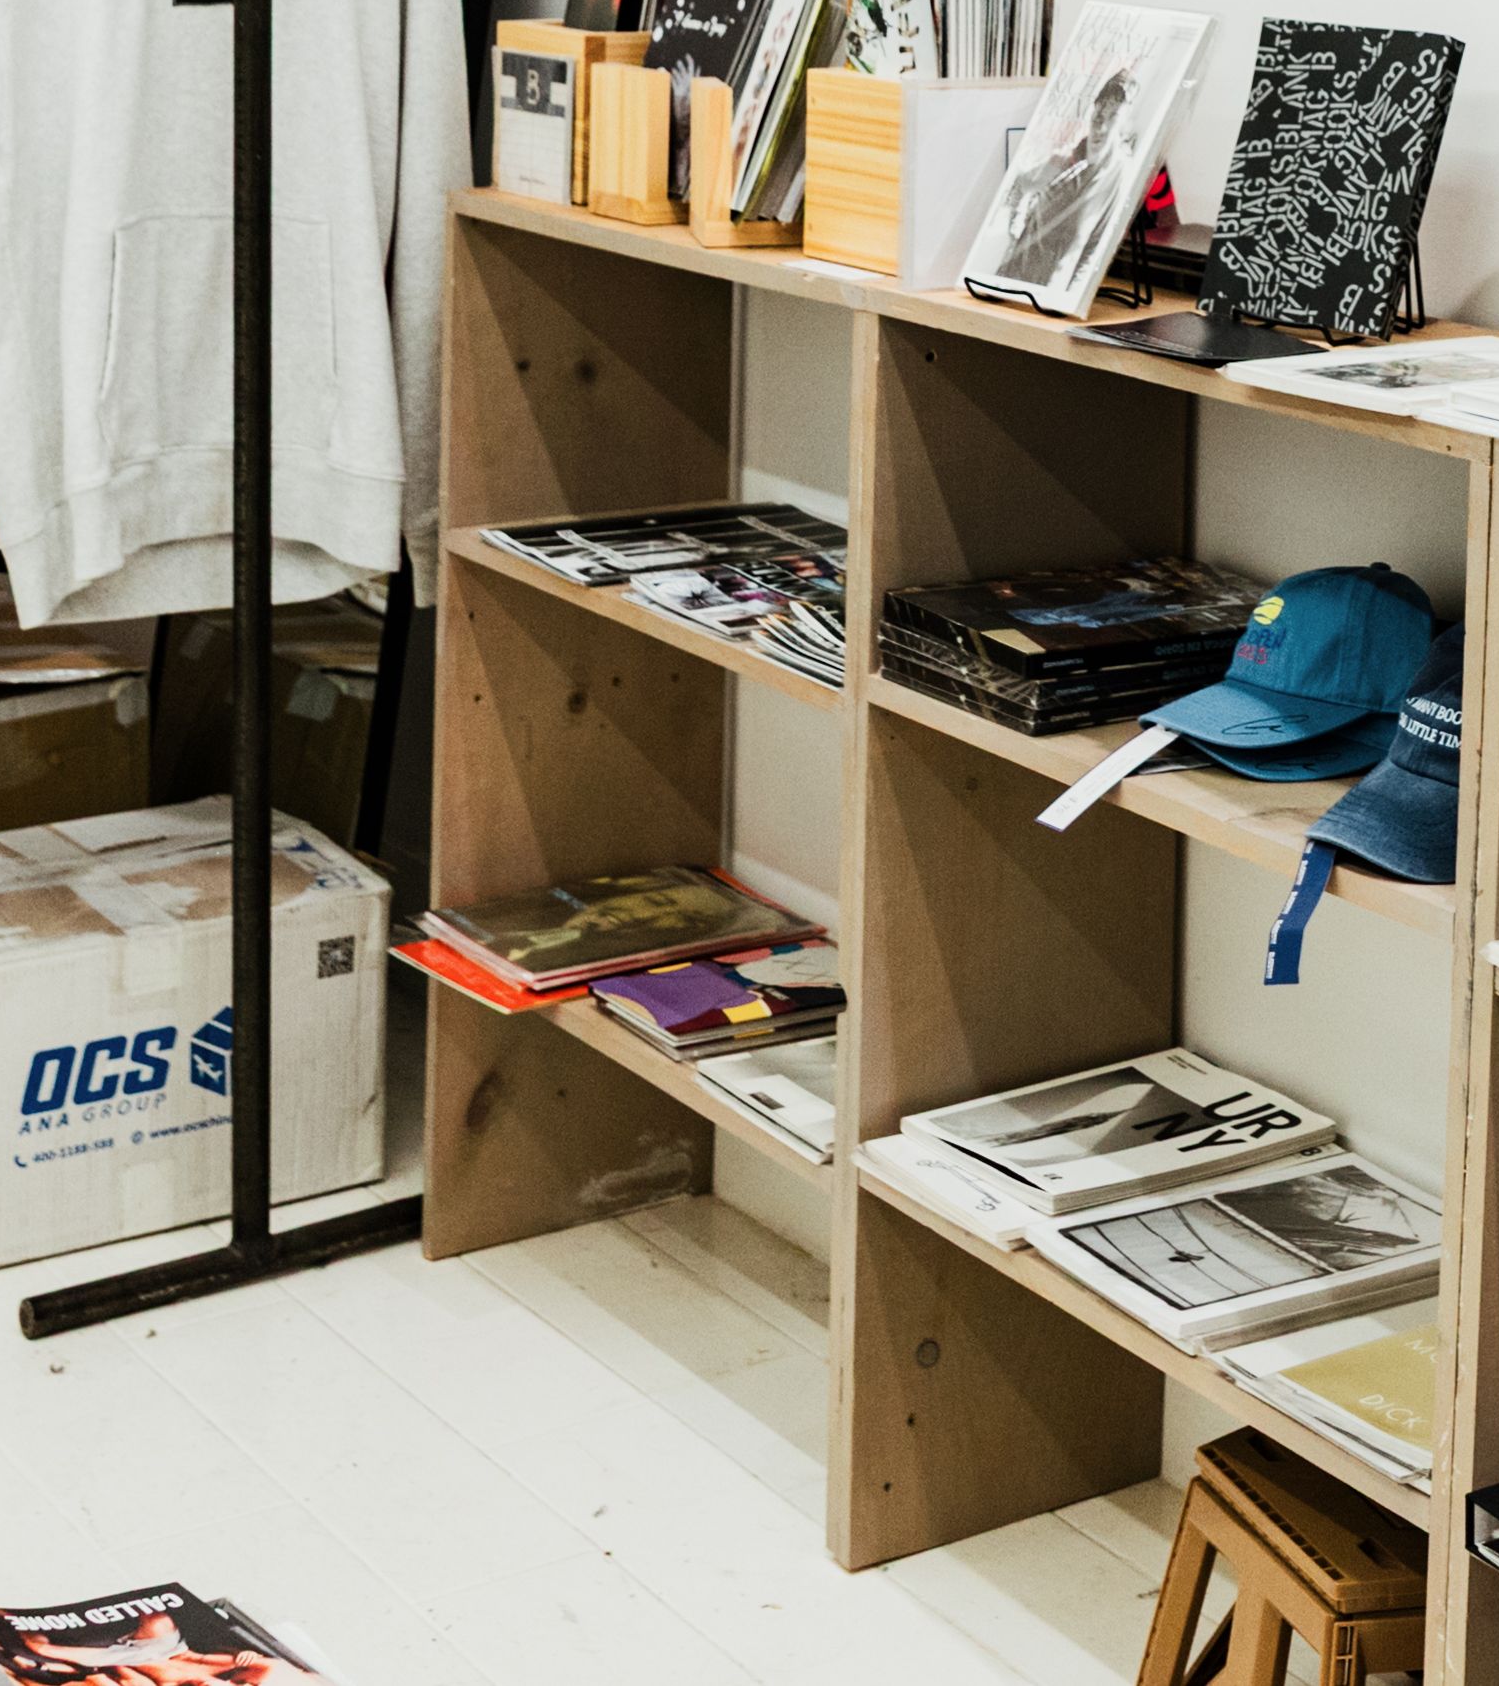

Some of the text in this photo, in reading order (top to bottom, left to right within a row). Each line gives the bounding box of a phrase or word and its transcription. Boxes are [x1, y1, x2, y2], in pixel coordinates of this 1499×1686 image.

[1407, 719, 1440, 743] LITTLE
[21, 1026, 178, 1116] OCS
[18, 1092, 167, 1135] ANA GROUP
[1131, 1110, 1249, 1154] NY
[1201, 1090, 1304, 1141] UR
[1357, 1391, 1432, 1430] DICK
[2, 1592, 185, 1633] CALLED HOME
